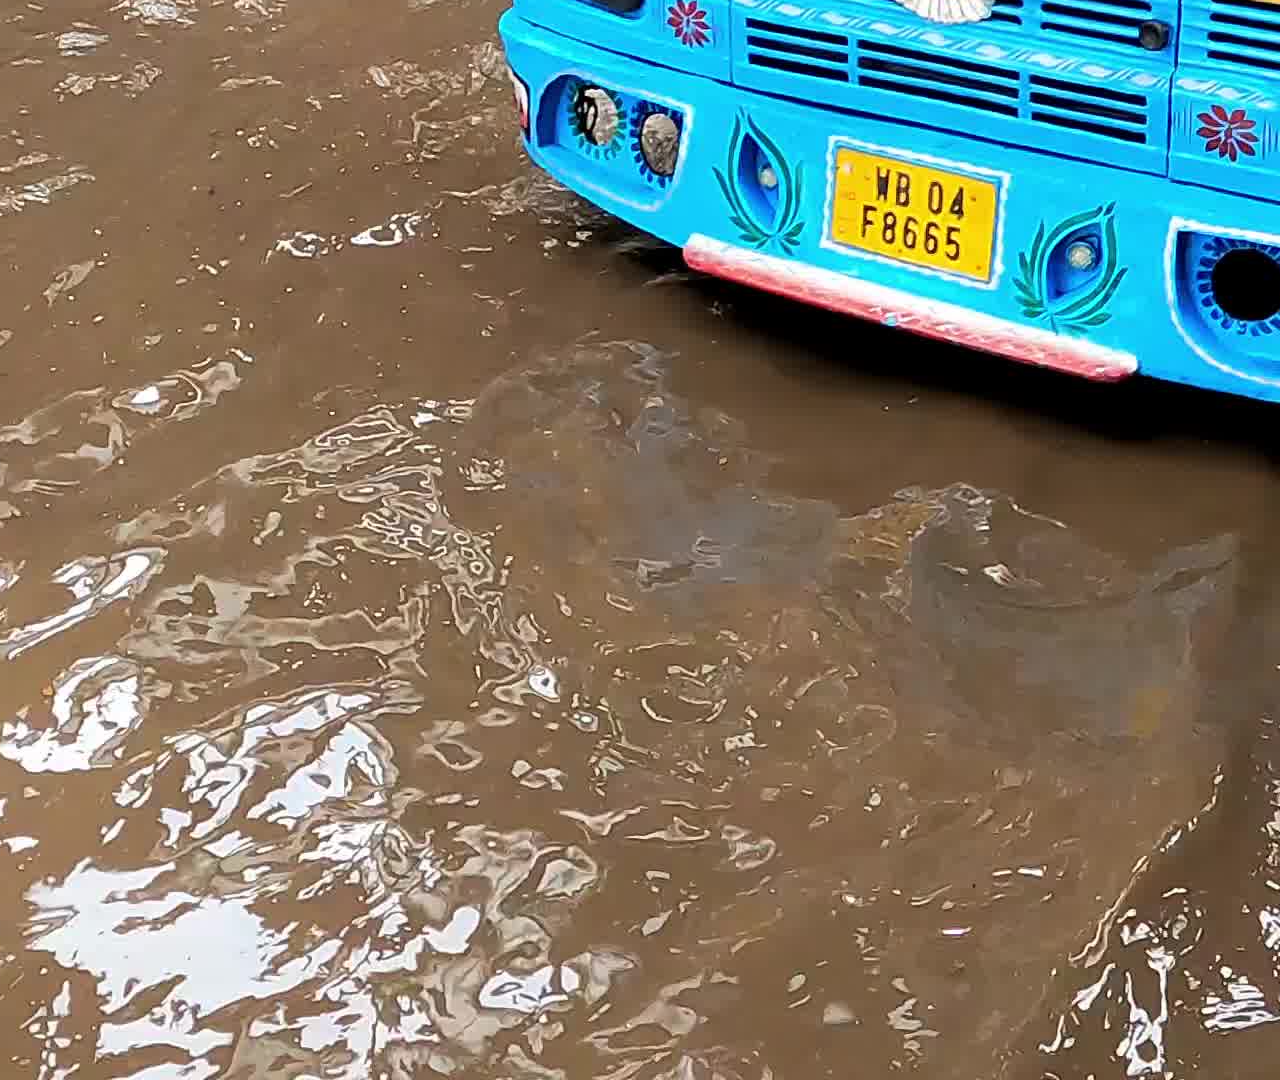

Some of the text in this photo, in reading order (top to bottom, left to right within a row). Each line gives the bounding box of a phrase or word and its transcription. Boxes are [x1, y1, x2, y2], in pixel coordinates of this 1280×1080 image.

[876, 167, 964, 220] WB 04
[862, 205, 961, 261] F8665
